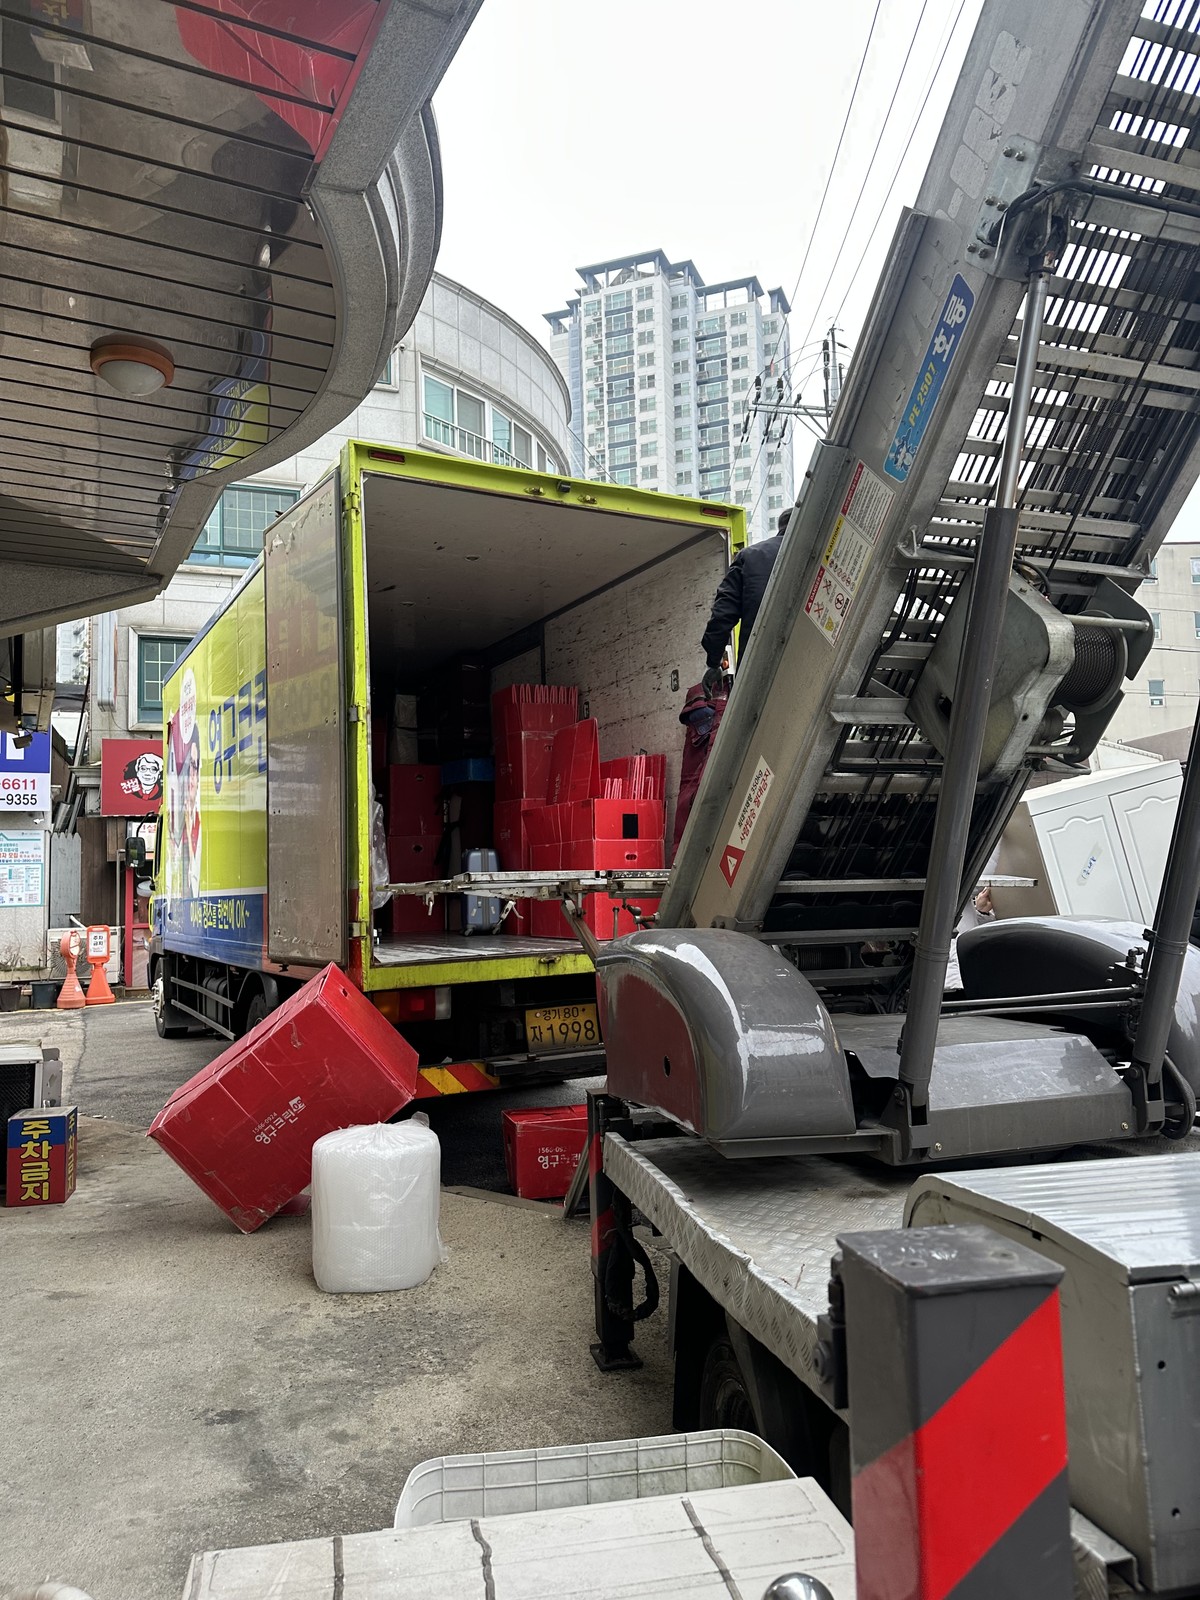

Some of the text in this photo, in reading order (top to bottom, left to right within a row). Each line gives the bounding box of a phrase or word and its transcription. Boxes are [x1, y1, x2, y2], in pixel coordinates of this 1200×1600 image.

[932, 293, 967, 363] 호룡
[908, 403, 921, 427] PE
[916, 361, 937, 407] 2507
[827, 524, 840, 554] CAUTION
[809, 575, 821, 601] DANGER
[750, 769, 763, 795] 350kg
[739, 768, 770, 844] 사람탑승 절대금지
[203, 900, 216, 929] 청소를
[218, 899, 234, 930] 한번에
[543, 1007, 579, 1021] 경기 80
[530, 1019, 595, 1045] 자 1998
[252, 1112, 277, 1134] 1566-0924
[255, 1109, 298, 1144] 영구크린
[20, 1120, 52, 1200] 주차금지
